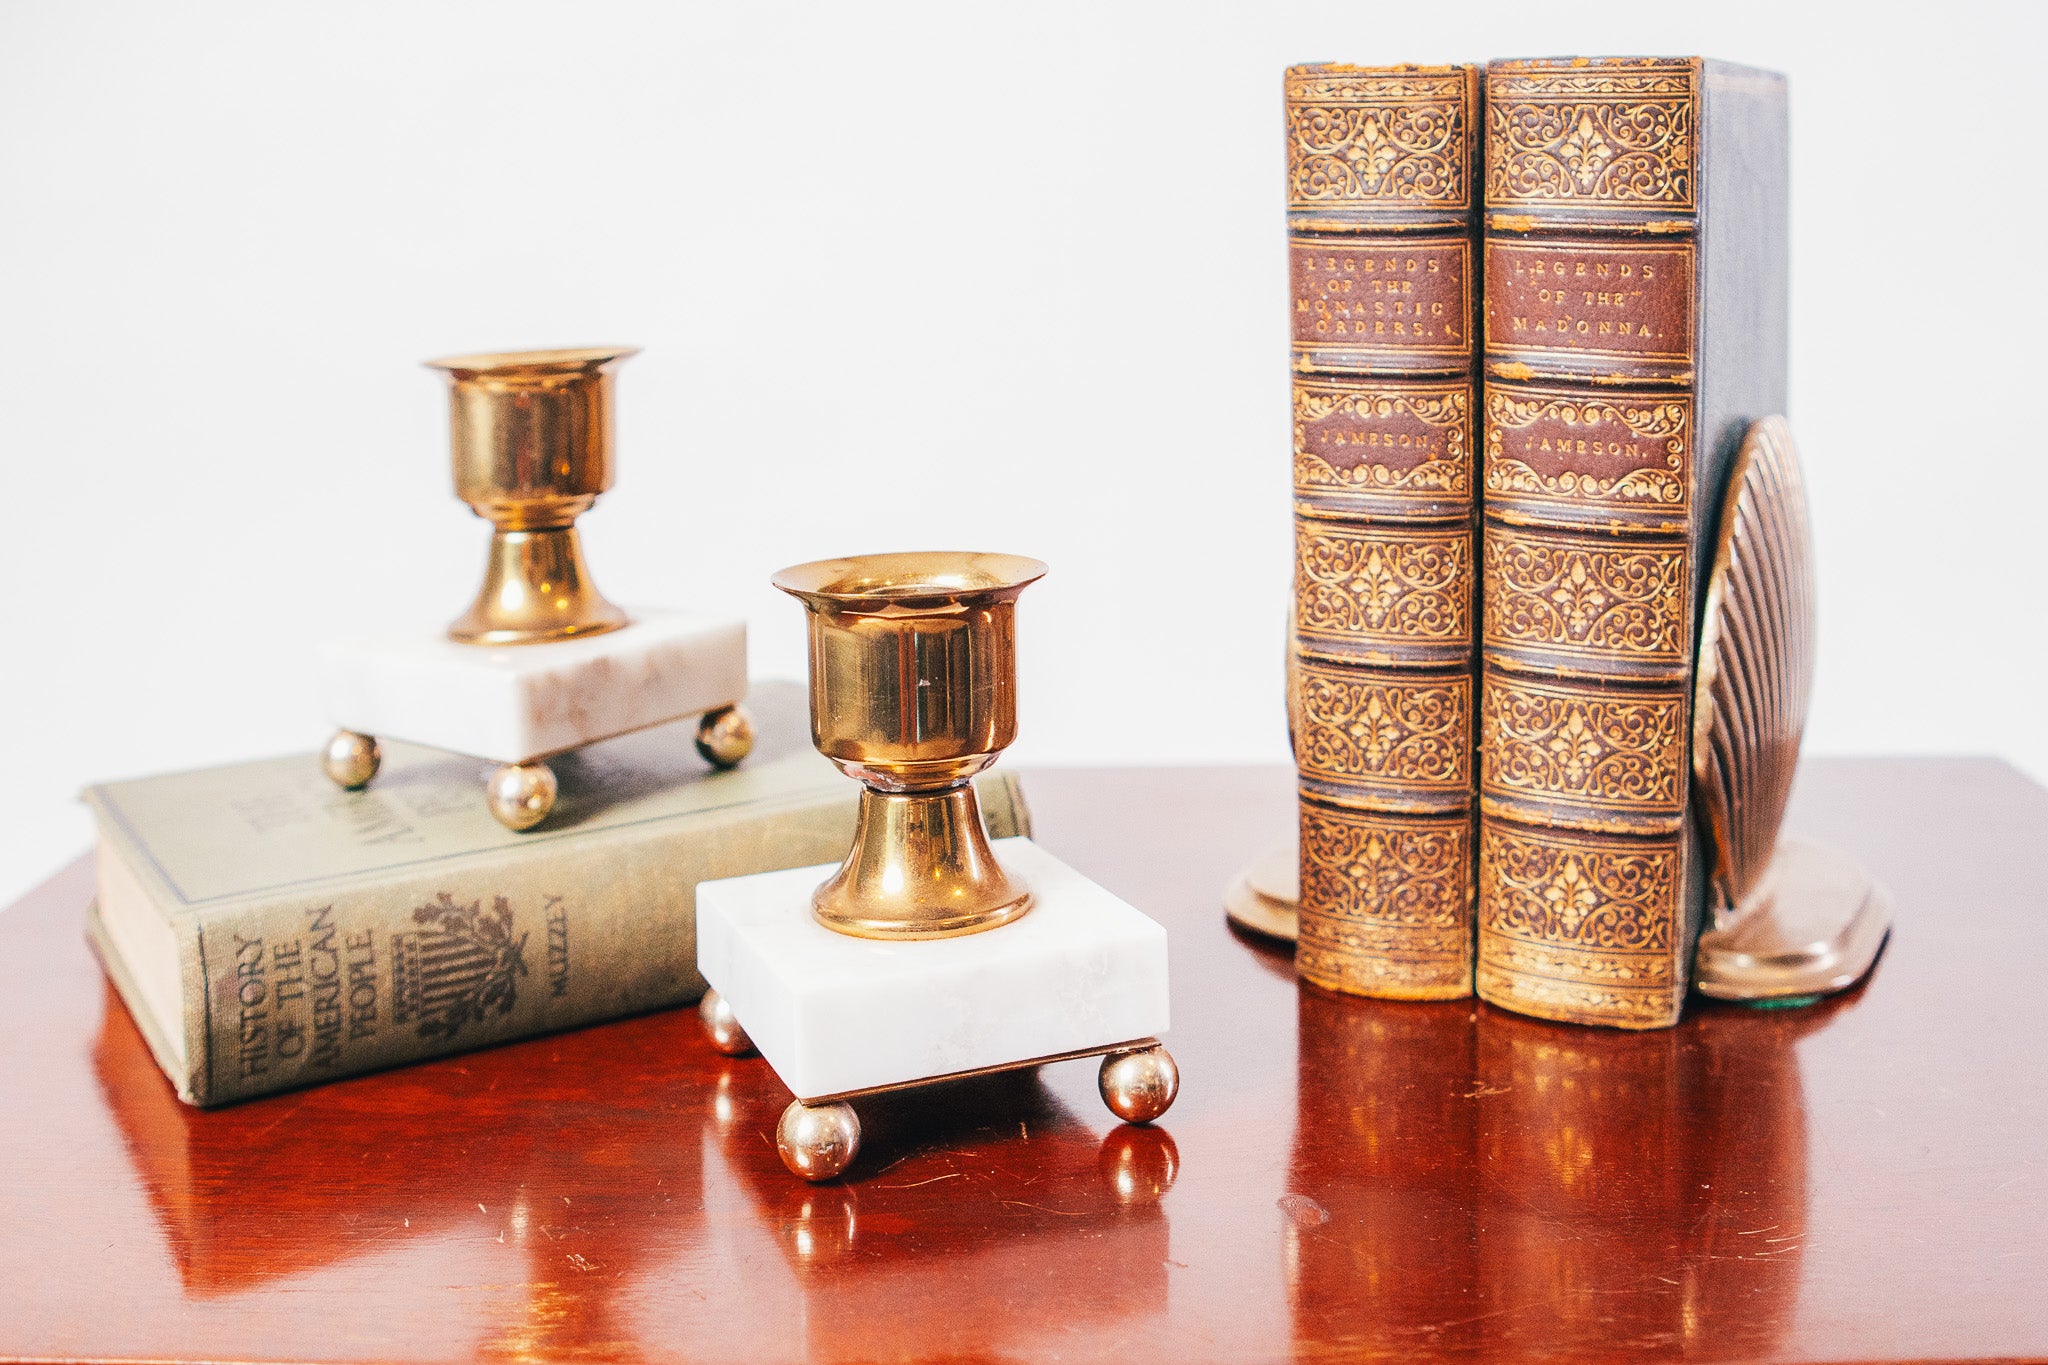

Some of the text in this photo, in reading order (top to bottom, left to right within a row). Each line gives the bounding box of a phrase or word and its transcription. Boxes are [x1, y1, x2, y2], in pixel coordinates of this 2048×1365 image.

[1307, 257, 1439, 273] LEGENDS
[1515, 260, 1653, 278] LEGENDS
[1327, 279, 1412, 293] OF THE
[1297, 299, 1443, 316] MONASTIC
[1538, 289, 1624, 306] OF THE
[1316, 319, 1433, 337] ORDERS.
[1513, 316, 1663, 338] MADONNA.
[1525, 436, 1646, 458] JAMESON.
[543, 893, 569, 997] MUZZEY
[305, 903, 341, 1069] AMERICAN
[346, 928, 378, 1040] PEOPLE
[234, 933, 269, 1079] HISTORY
[273, 939, 305, 1060] OF THE
